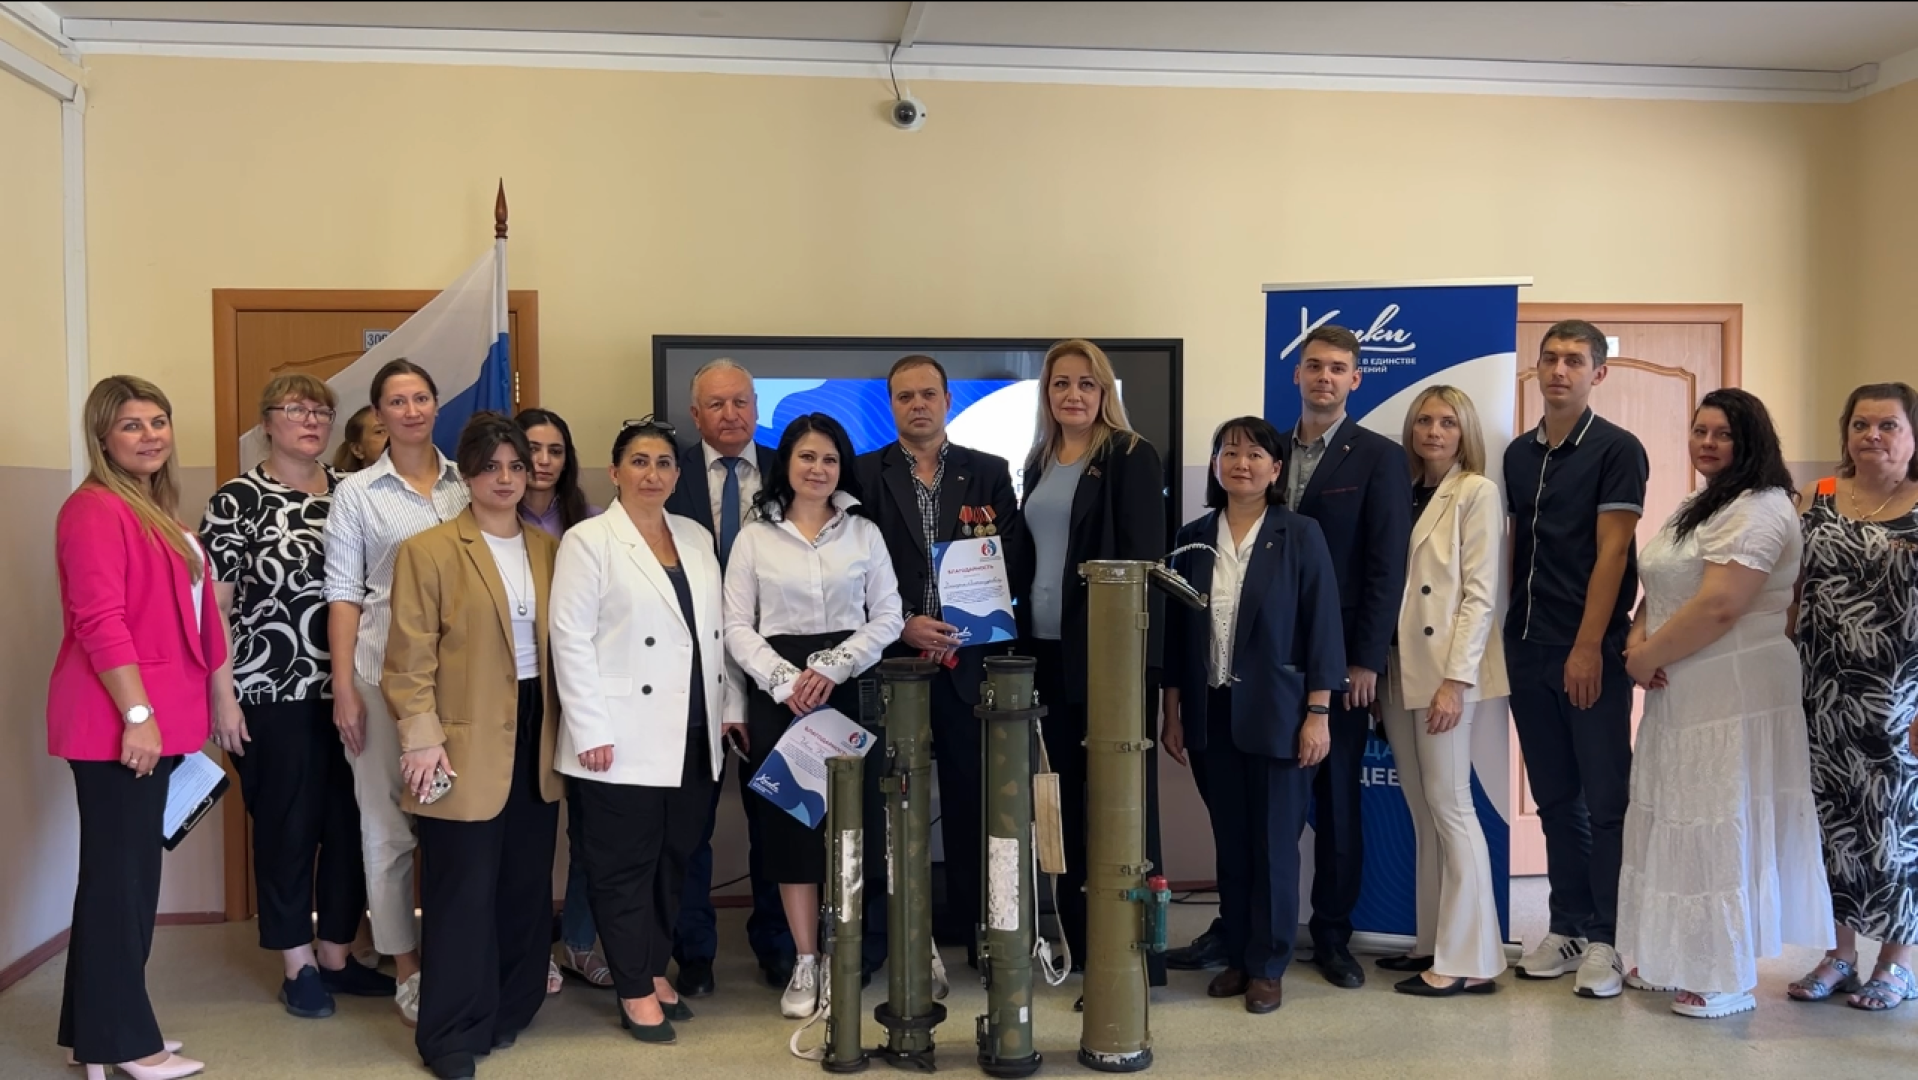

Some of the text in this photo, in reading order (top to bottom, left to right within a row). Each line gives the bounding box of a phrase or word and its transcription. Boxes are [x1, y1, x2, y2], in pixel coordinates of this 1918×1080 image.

[1370, 357, 1417, 366] ЕДИНСТВЕ
[1357, 365, 1388, 373] ЛЕНИЙ
[947, 564, 994, 575] БЛАГОДАРНОСТЬ
